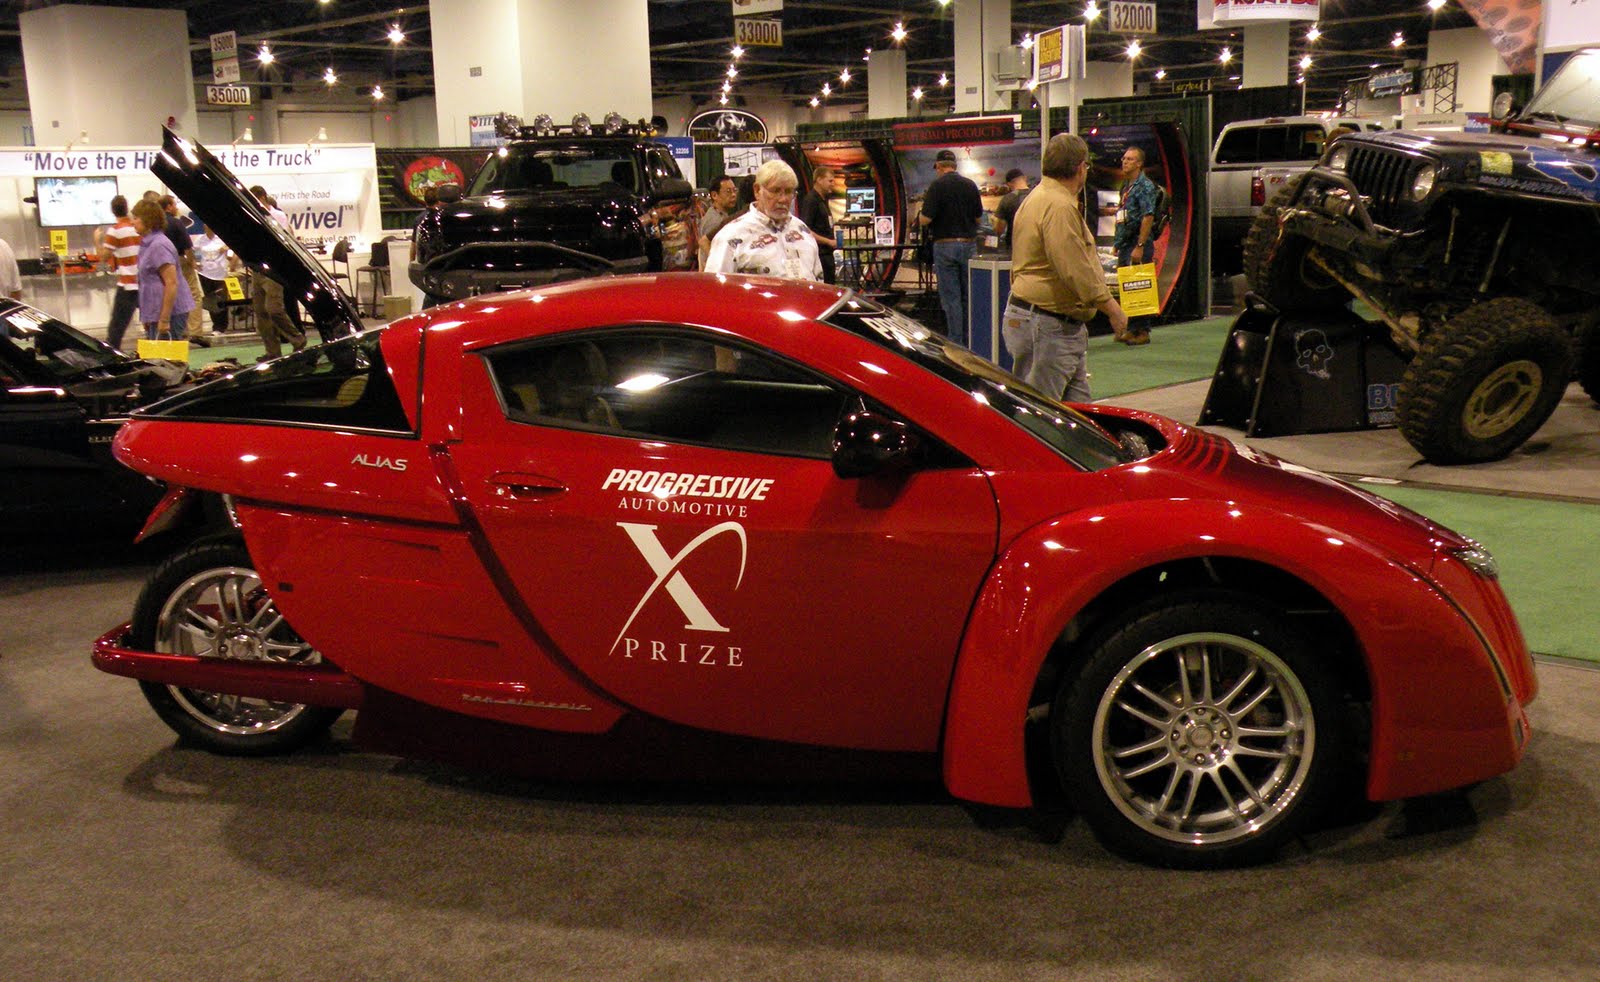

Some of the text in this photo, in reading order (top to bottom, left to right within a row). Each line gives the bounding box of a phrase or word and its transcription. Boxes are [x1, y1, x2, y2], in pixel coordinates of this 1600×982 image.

[1114, 4, 1152, 30] 32000
[739, 21, 778, 43] 33000
[210, 87, 247, 103] 35000
[96, 152, 126, 170] the
[233, 151, 260, 167] the
[297, 191, 310, 199] the
[312, 190, 331, 199] Road
[289, 204, 344, 230] wivel
[350, 453, 409, 472] ALIAS
[601, 468, 776, 501] PROGRESSIVE
[618, 496, 749, 518] AUTOMOTIVE
[608, 520, 748, 657] X
[623, 637, 744, 667] PRIZE
